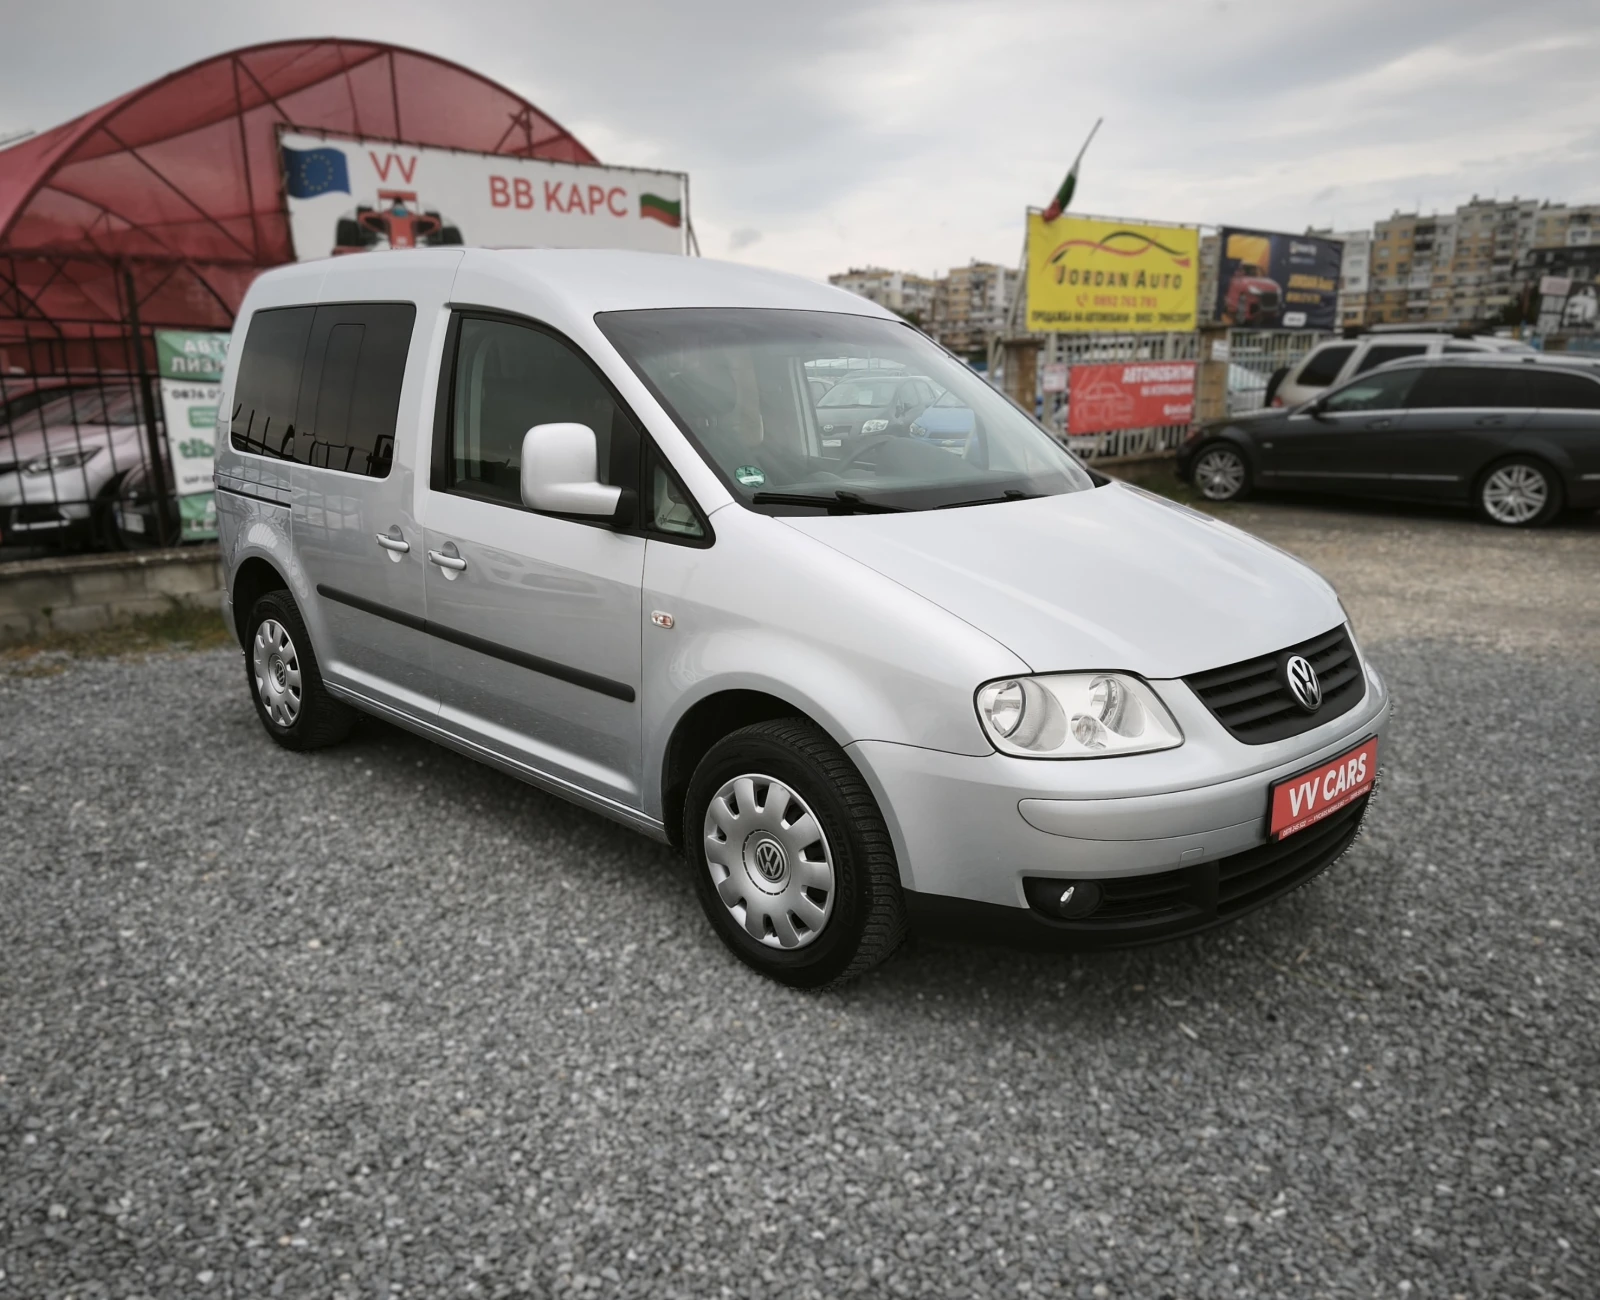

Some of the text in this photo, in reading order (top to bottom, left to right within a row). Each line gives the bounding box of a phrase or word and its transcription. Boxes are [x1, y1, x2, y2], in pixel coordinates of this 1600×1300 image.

[367, 150, 418, 184] VV
[488, 174, 629, 218] ВВ КАРС
[1055, 264, 1184, 290] JORDAN AUTO
[1289, 752, 1367, 818] VV CARS
